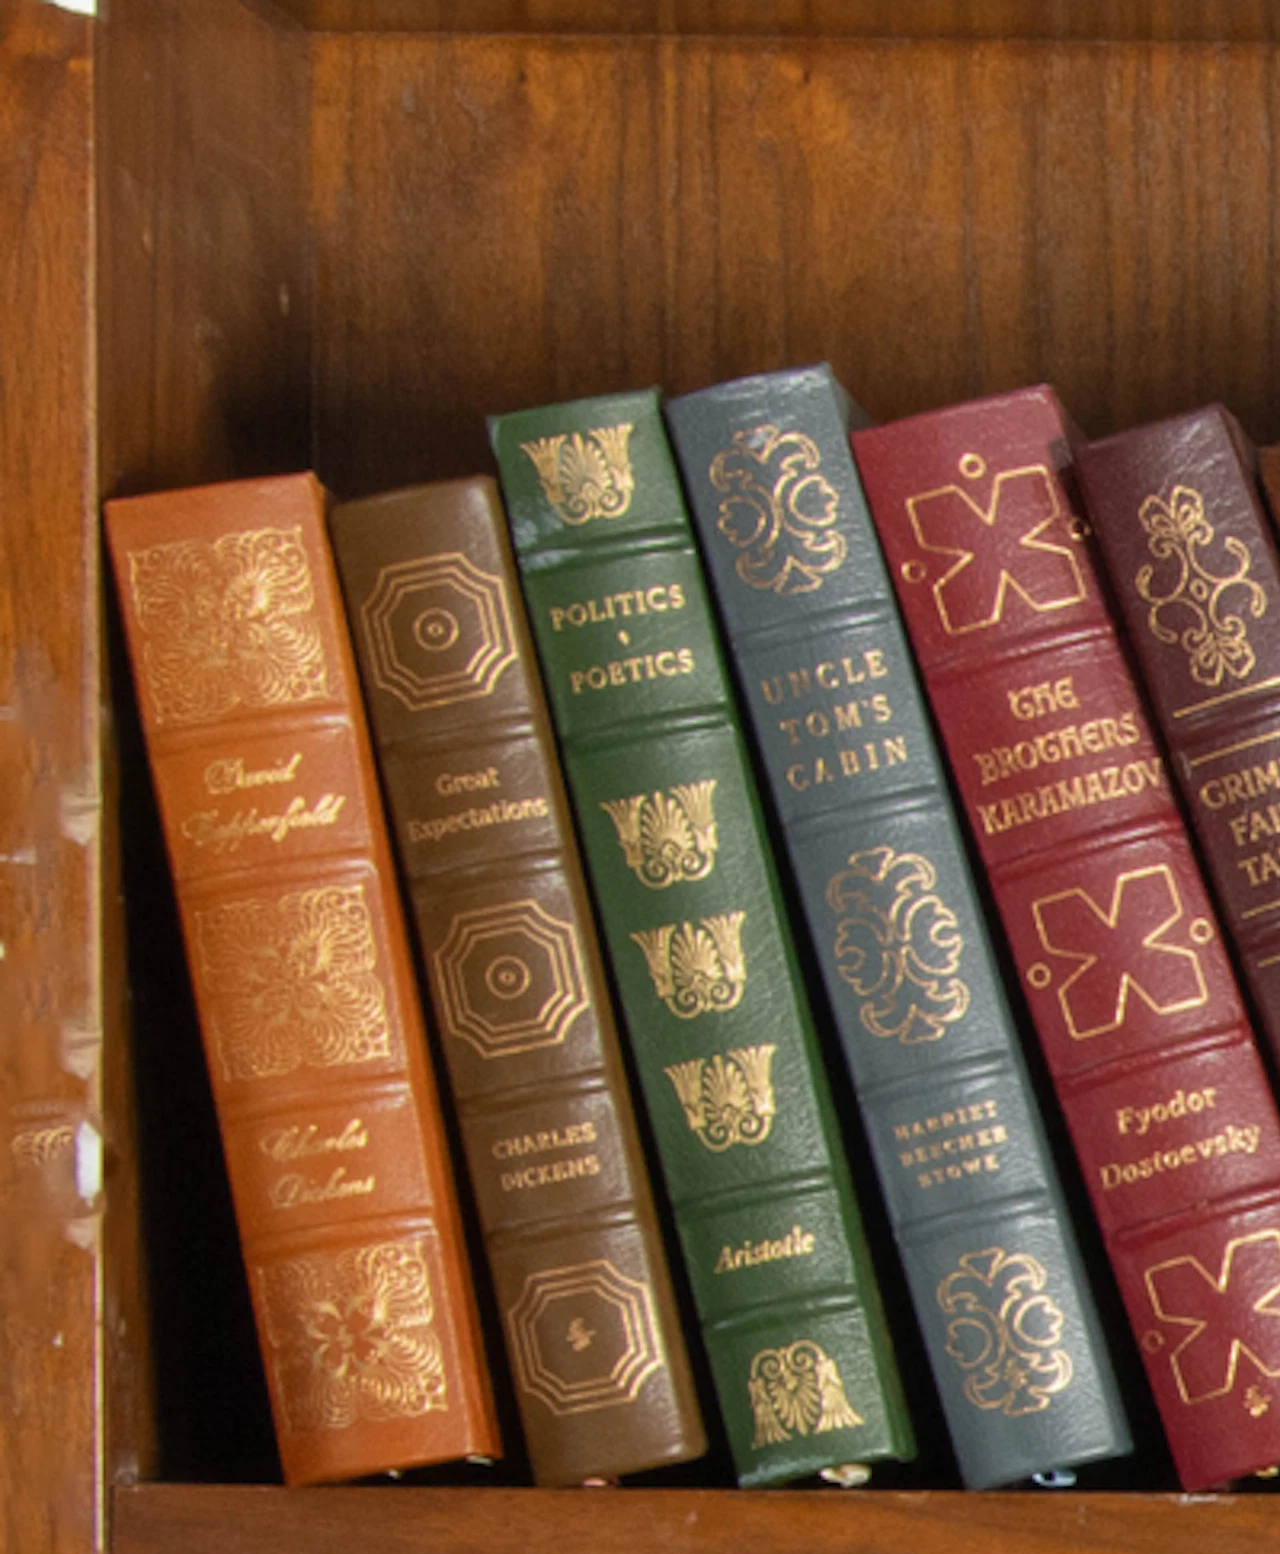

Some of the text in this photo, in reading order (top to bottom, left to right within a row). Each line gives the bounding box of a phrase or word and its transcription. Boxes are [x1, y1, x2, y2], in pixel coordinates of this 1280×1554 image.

[550, 584, 686, 631] POLITICS
[570, 648, 695, 694] POETICS
[760, 649, 888, 706] UNCLE
[780, 694, 892, 746] TOM'S
[437, 766, 500, 796] Great
[786, 736, 908, 791] CABIN
[977, 756, 1166, 835] KARAMAZOV
[407, 797, 549, 842] Expectations
[893, 1099, 998, 1142] HARRIET
[1116, 1087, 1217, 1135] Fyodor
[259, 1119, 369, 1162] Charles
[491, 1122, 597, 1159] CHARLES
[899, 1124, 1008, 1166] BEECHER
[1101, 1124, 1261, 1190] Dostoevsky
[269, 1168, 375, 1209] Dickens
[501, 1154, 601, 1192] DICKENS
[918, 1153, 1000, 1188] STOWE
[714, 1224, 815, 1273] Aristotle
